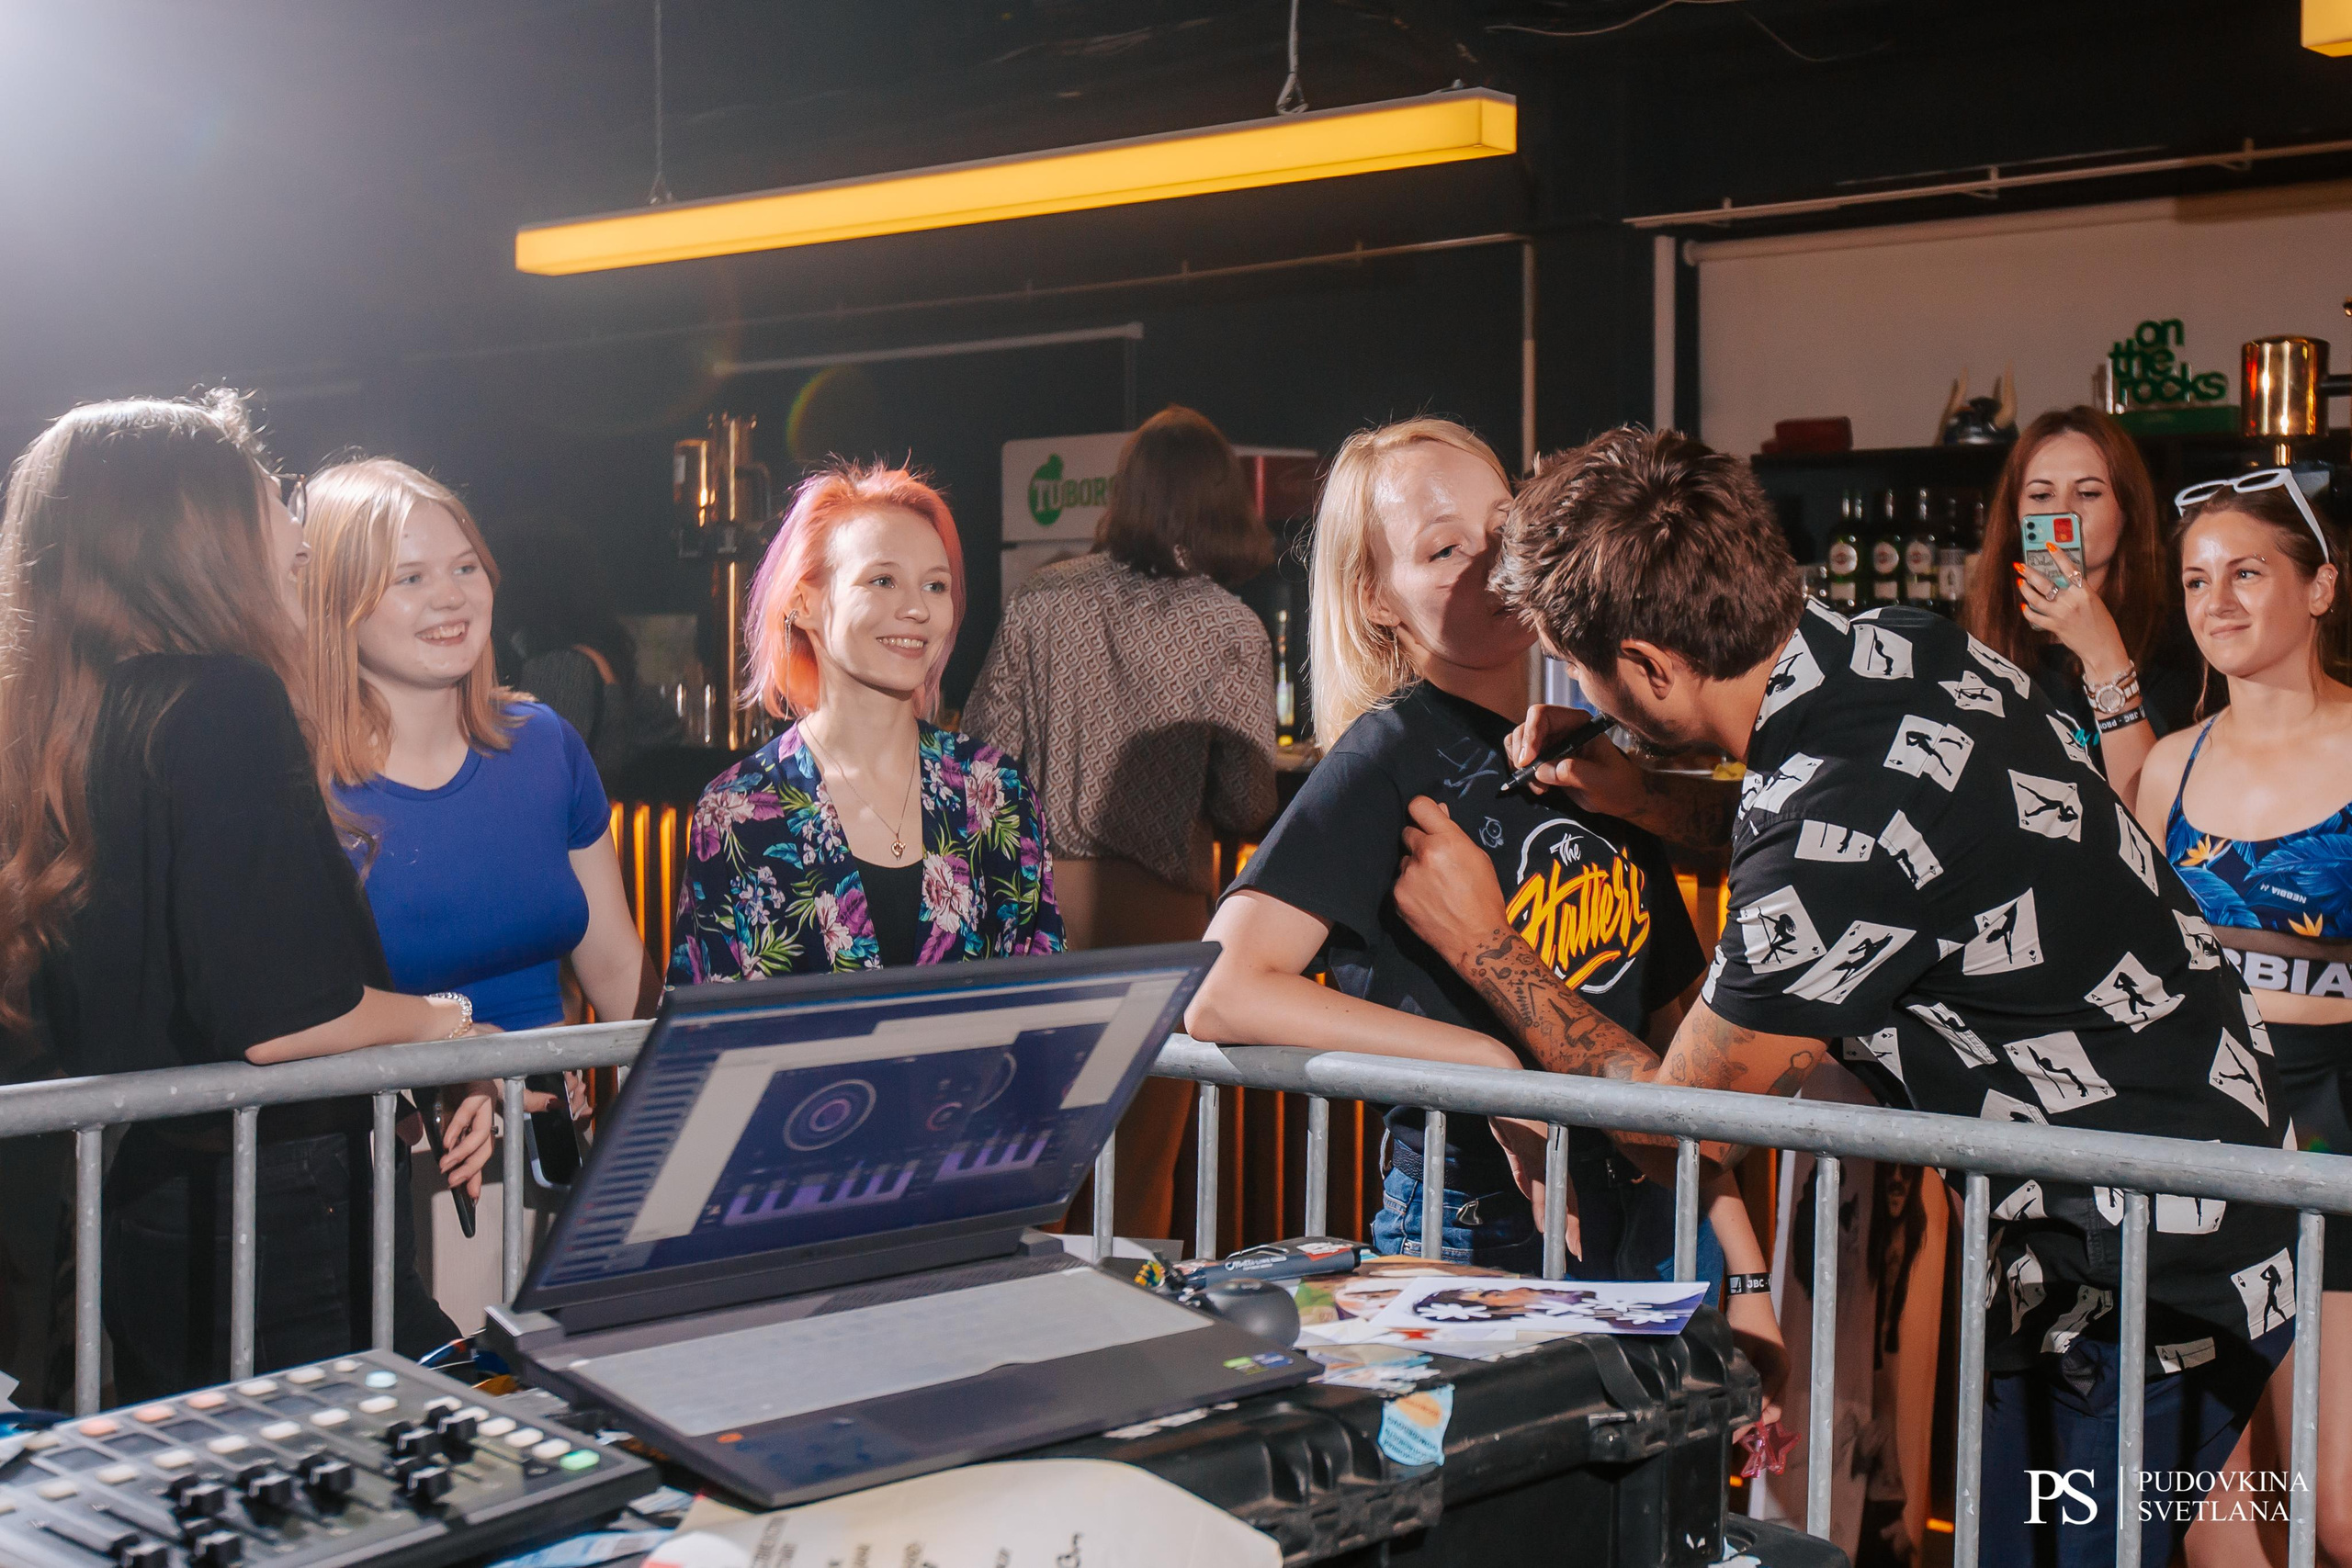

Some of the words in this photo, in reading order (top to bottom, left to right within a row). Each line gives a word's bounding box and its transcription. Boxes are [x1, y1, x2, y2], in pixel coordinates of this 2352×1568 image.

[2135, 318, 2185, 346] on
[2109, 338, 2176, 379] the
[2120, 361, 2228, 403] rocks
[1550, 833, 1584, 866] the
[1747, 1279, 1764, 1289] JBC
